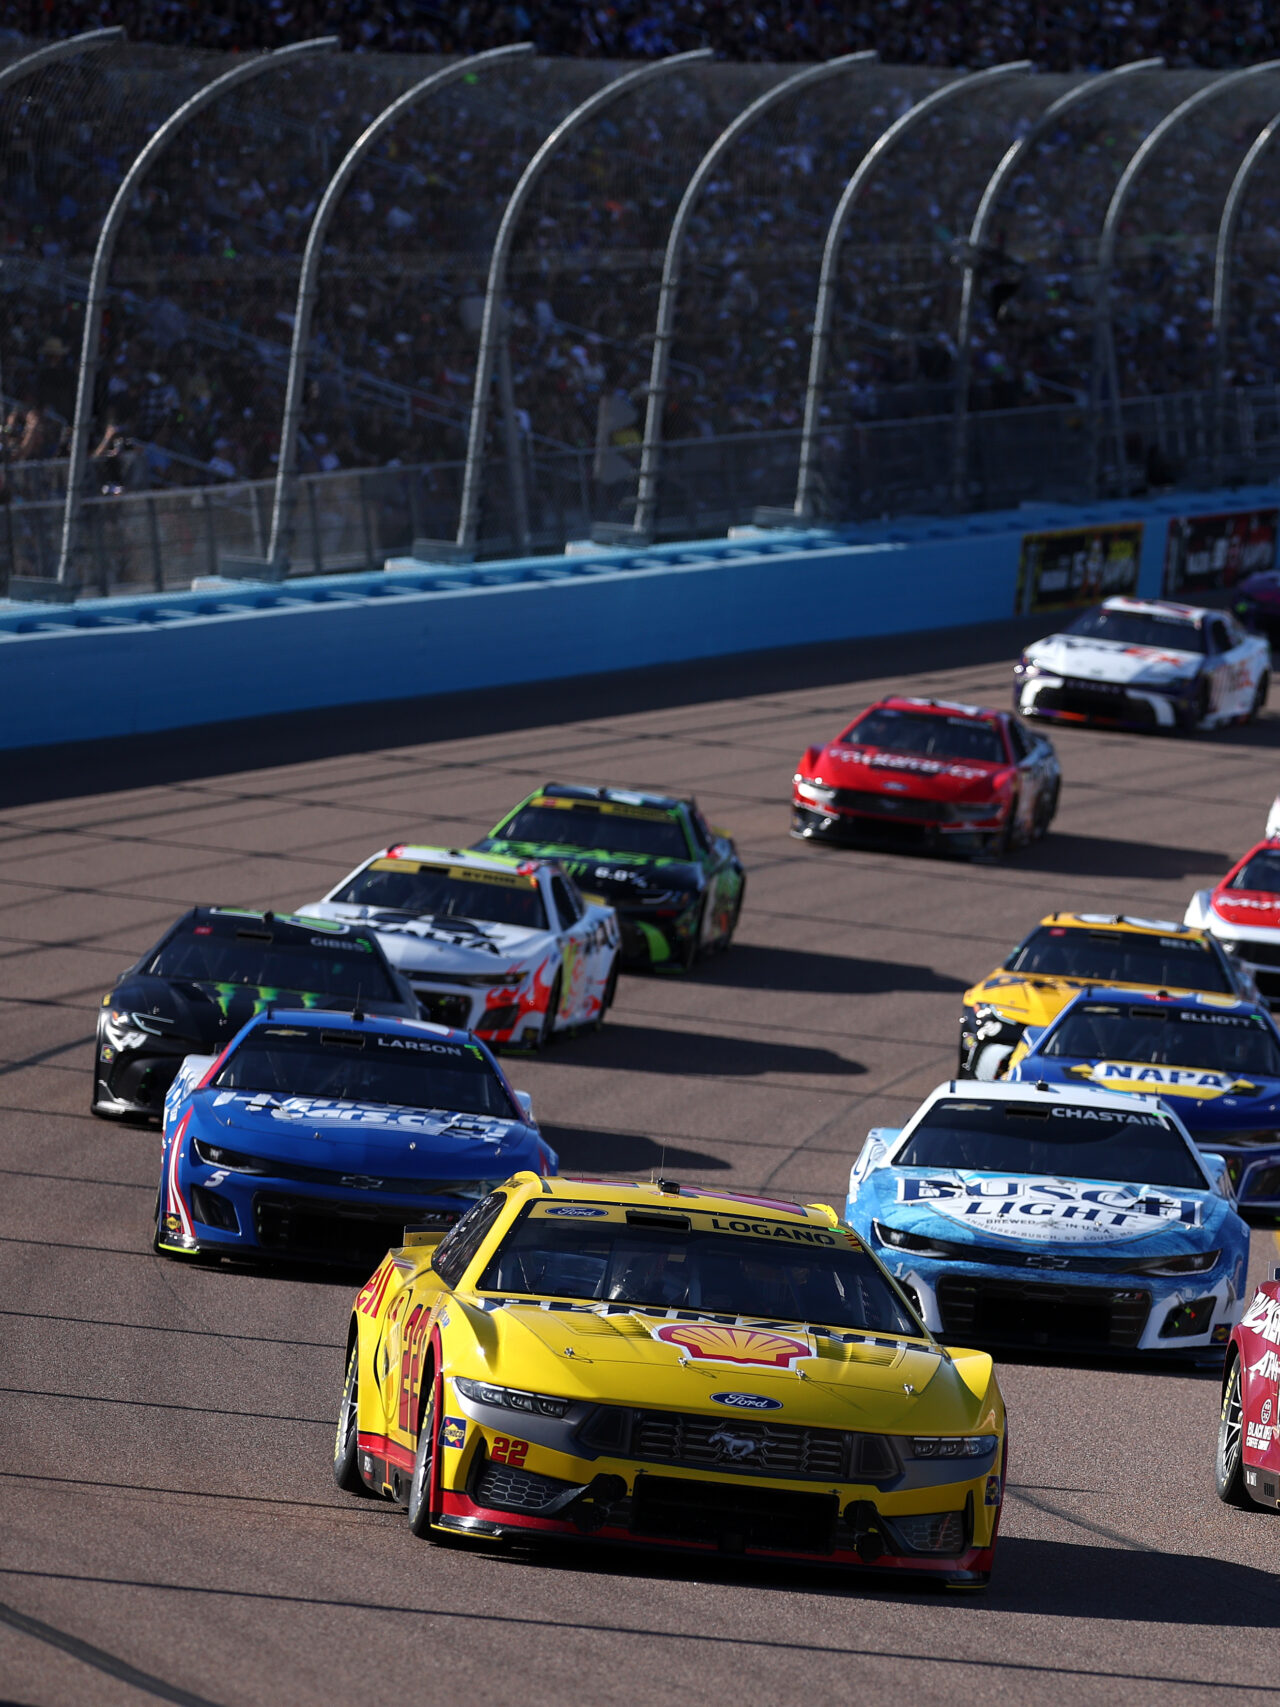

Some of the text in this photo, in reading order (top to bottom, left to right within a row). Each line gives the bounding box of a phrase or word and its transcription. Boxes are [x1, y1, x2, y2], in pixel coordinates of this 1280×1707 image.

[1181, 1012, 1251, 1027] ELLIOTT
[377, 1037, 461, 1056] LARSON
[1104, 1064, 1223, 1087] NAPA
[1052, 1107, 1163, 1126] CHASTAIN
[204, 1170, 231, 1187] 5
[902, 1177, 1198, 1225] BUSCH
[964, 1201, 1138, 1226] LIGHT
[711, 1218, 834, 1246] LOGANO
[894, 1262, 903, 1276] 1
[399, 1304, 432, 1437] 22
[723, 1393, 769, 1410] Ford
[443, 1428, 465, 1440] SUNOCO
[491, 1436, 529, 1467] 22
